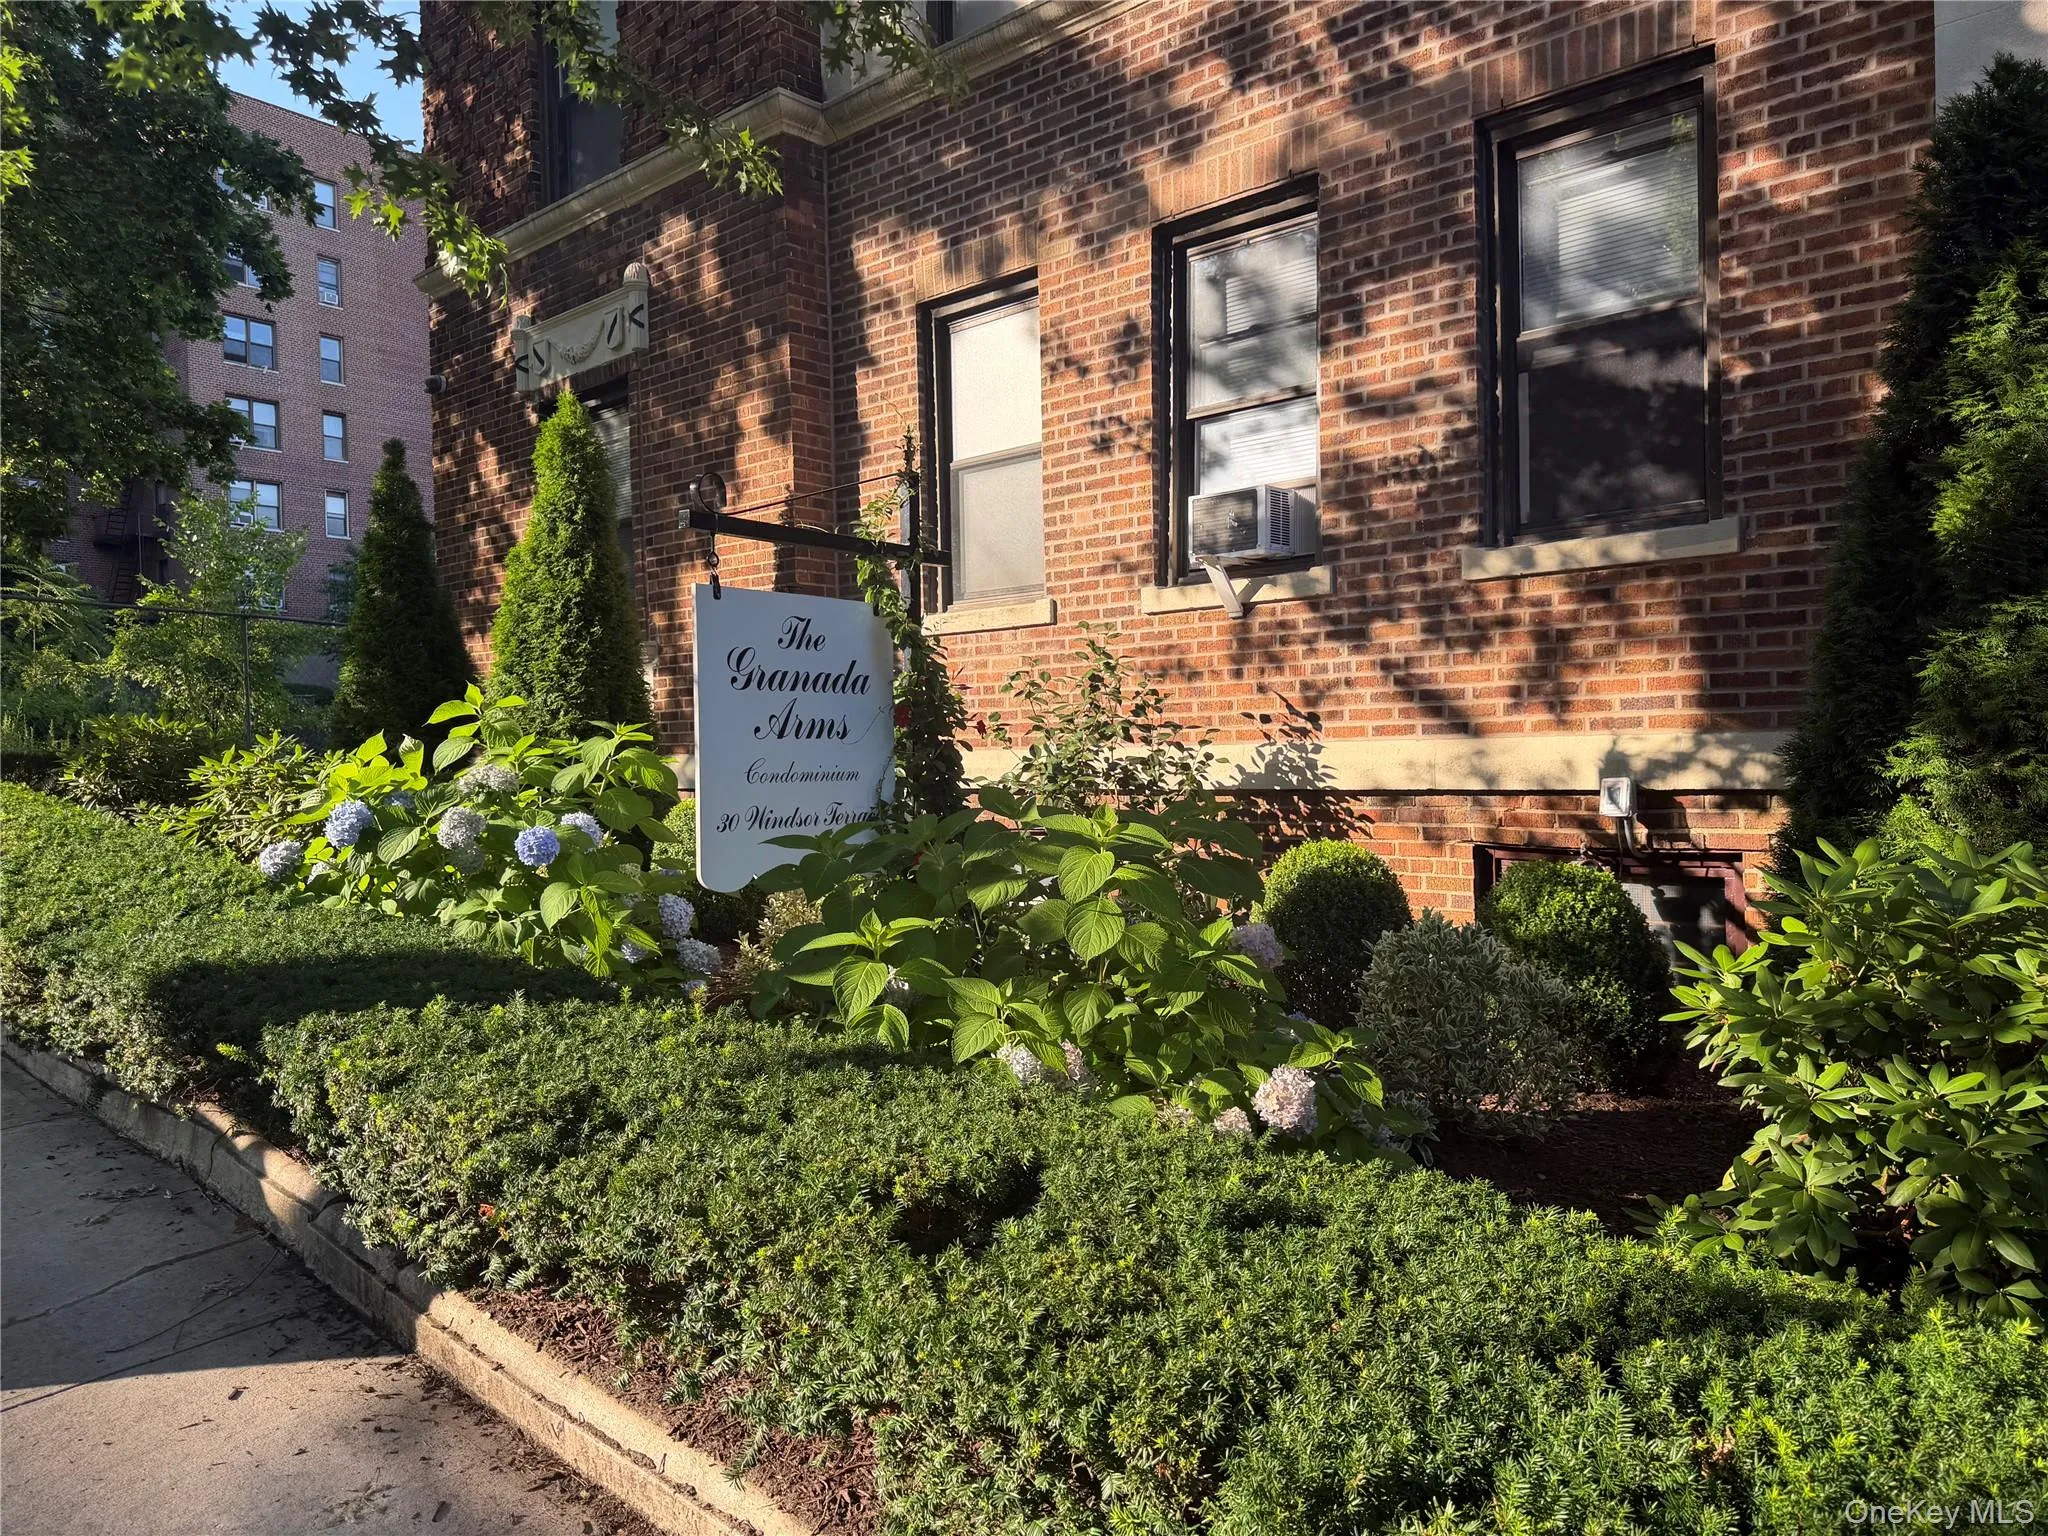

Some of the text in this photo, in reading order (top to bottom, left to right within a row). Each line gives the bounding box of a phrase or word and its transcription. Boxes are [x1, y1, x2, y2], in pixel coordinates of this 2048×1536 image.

[777, 615, 826, 652] The
[726, 646, 871, 696] Granada
[753, 697, 852, 742] Arms
[744, 757, 860, 785] Condominium
[716, 801, 878, 834] 30 Windsor Terra
